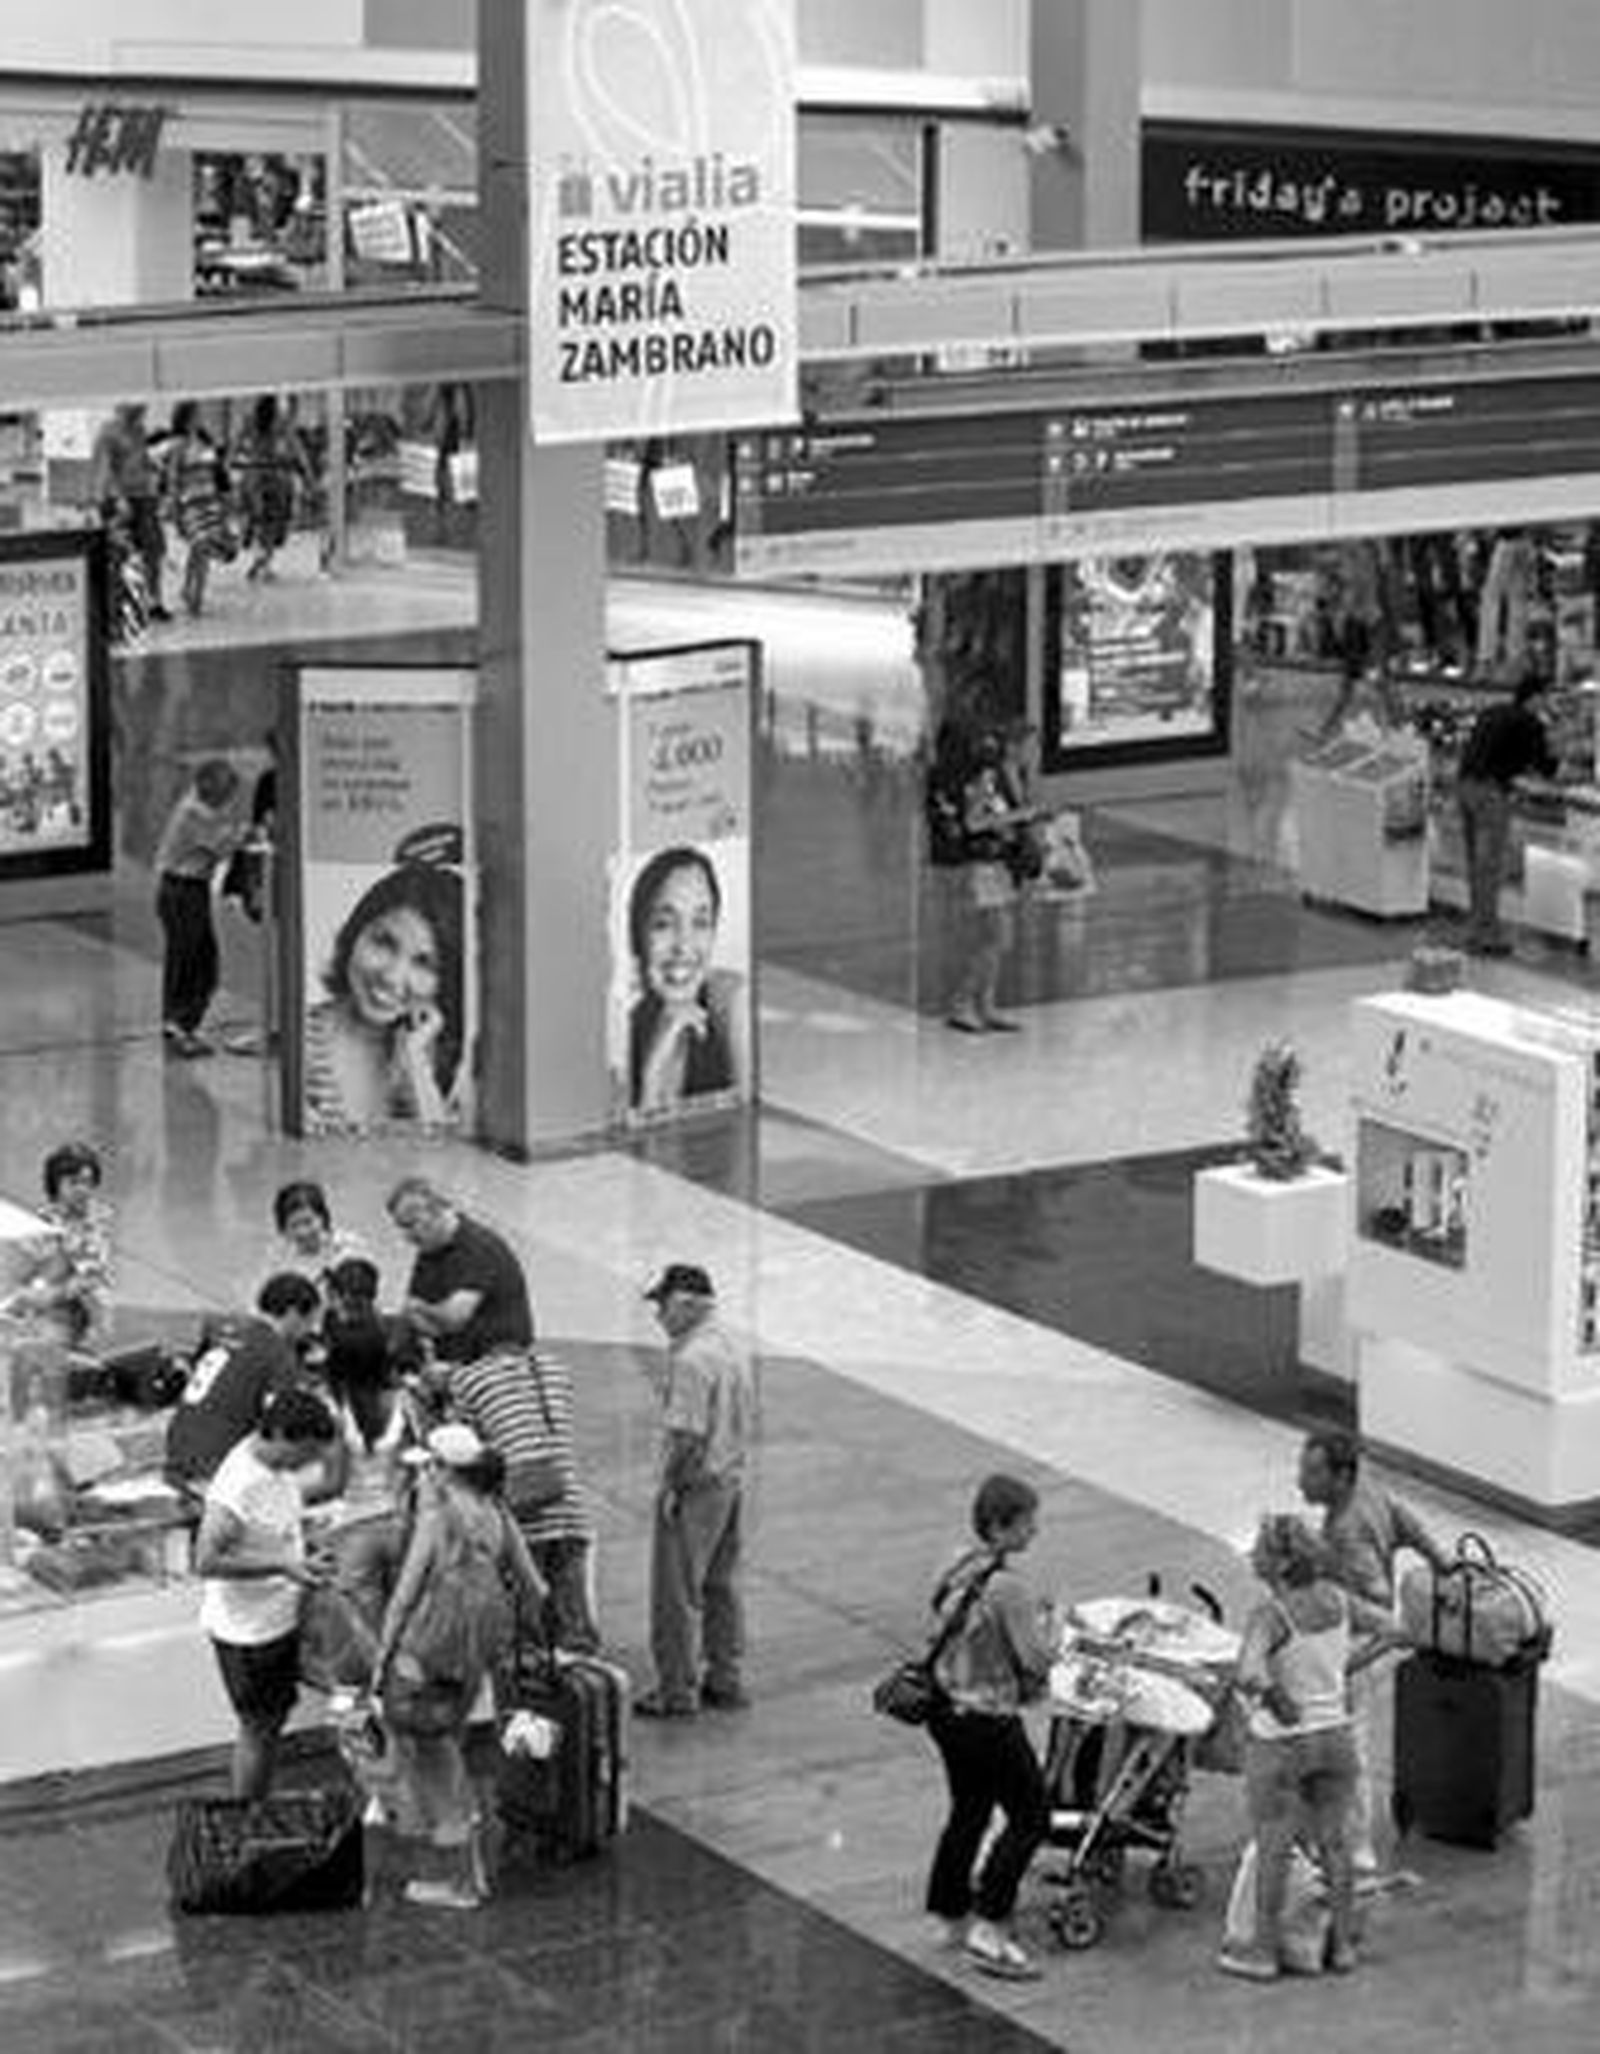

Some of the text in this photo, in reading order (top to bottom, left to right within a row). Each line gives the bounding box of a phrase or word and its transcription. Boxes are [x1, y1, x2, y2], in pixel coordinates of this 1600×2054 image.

[606, 153, 758, 214] vialia
[1185, 166, 1562, 225] friday's project
[558, 216, 729, 274] ESTACIÓN
[559, 272, 684, 327] MARÍA
[559, 325, 775, 382] ZAMBRANO
